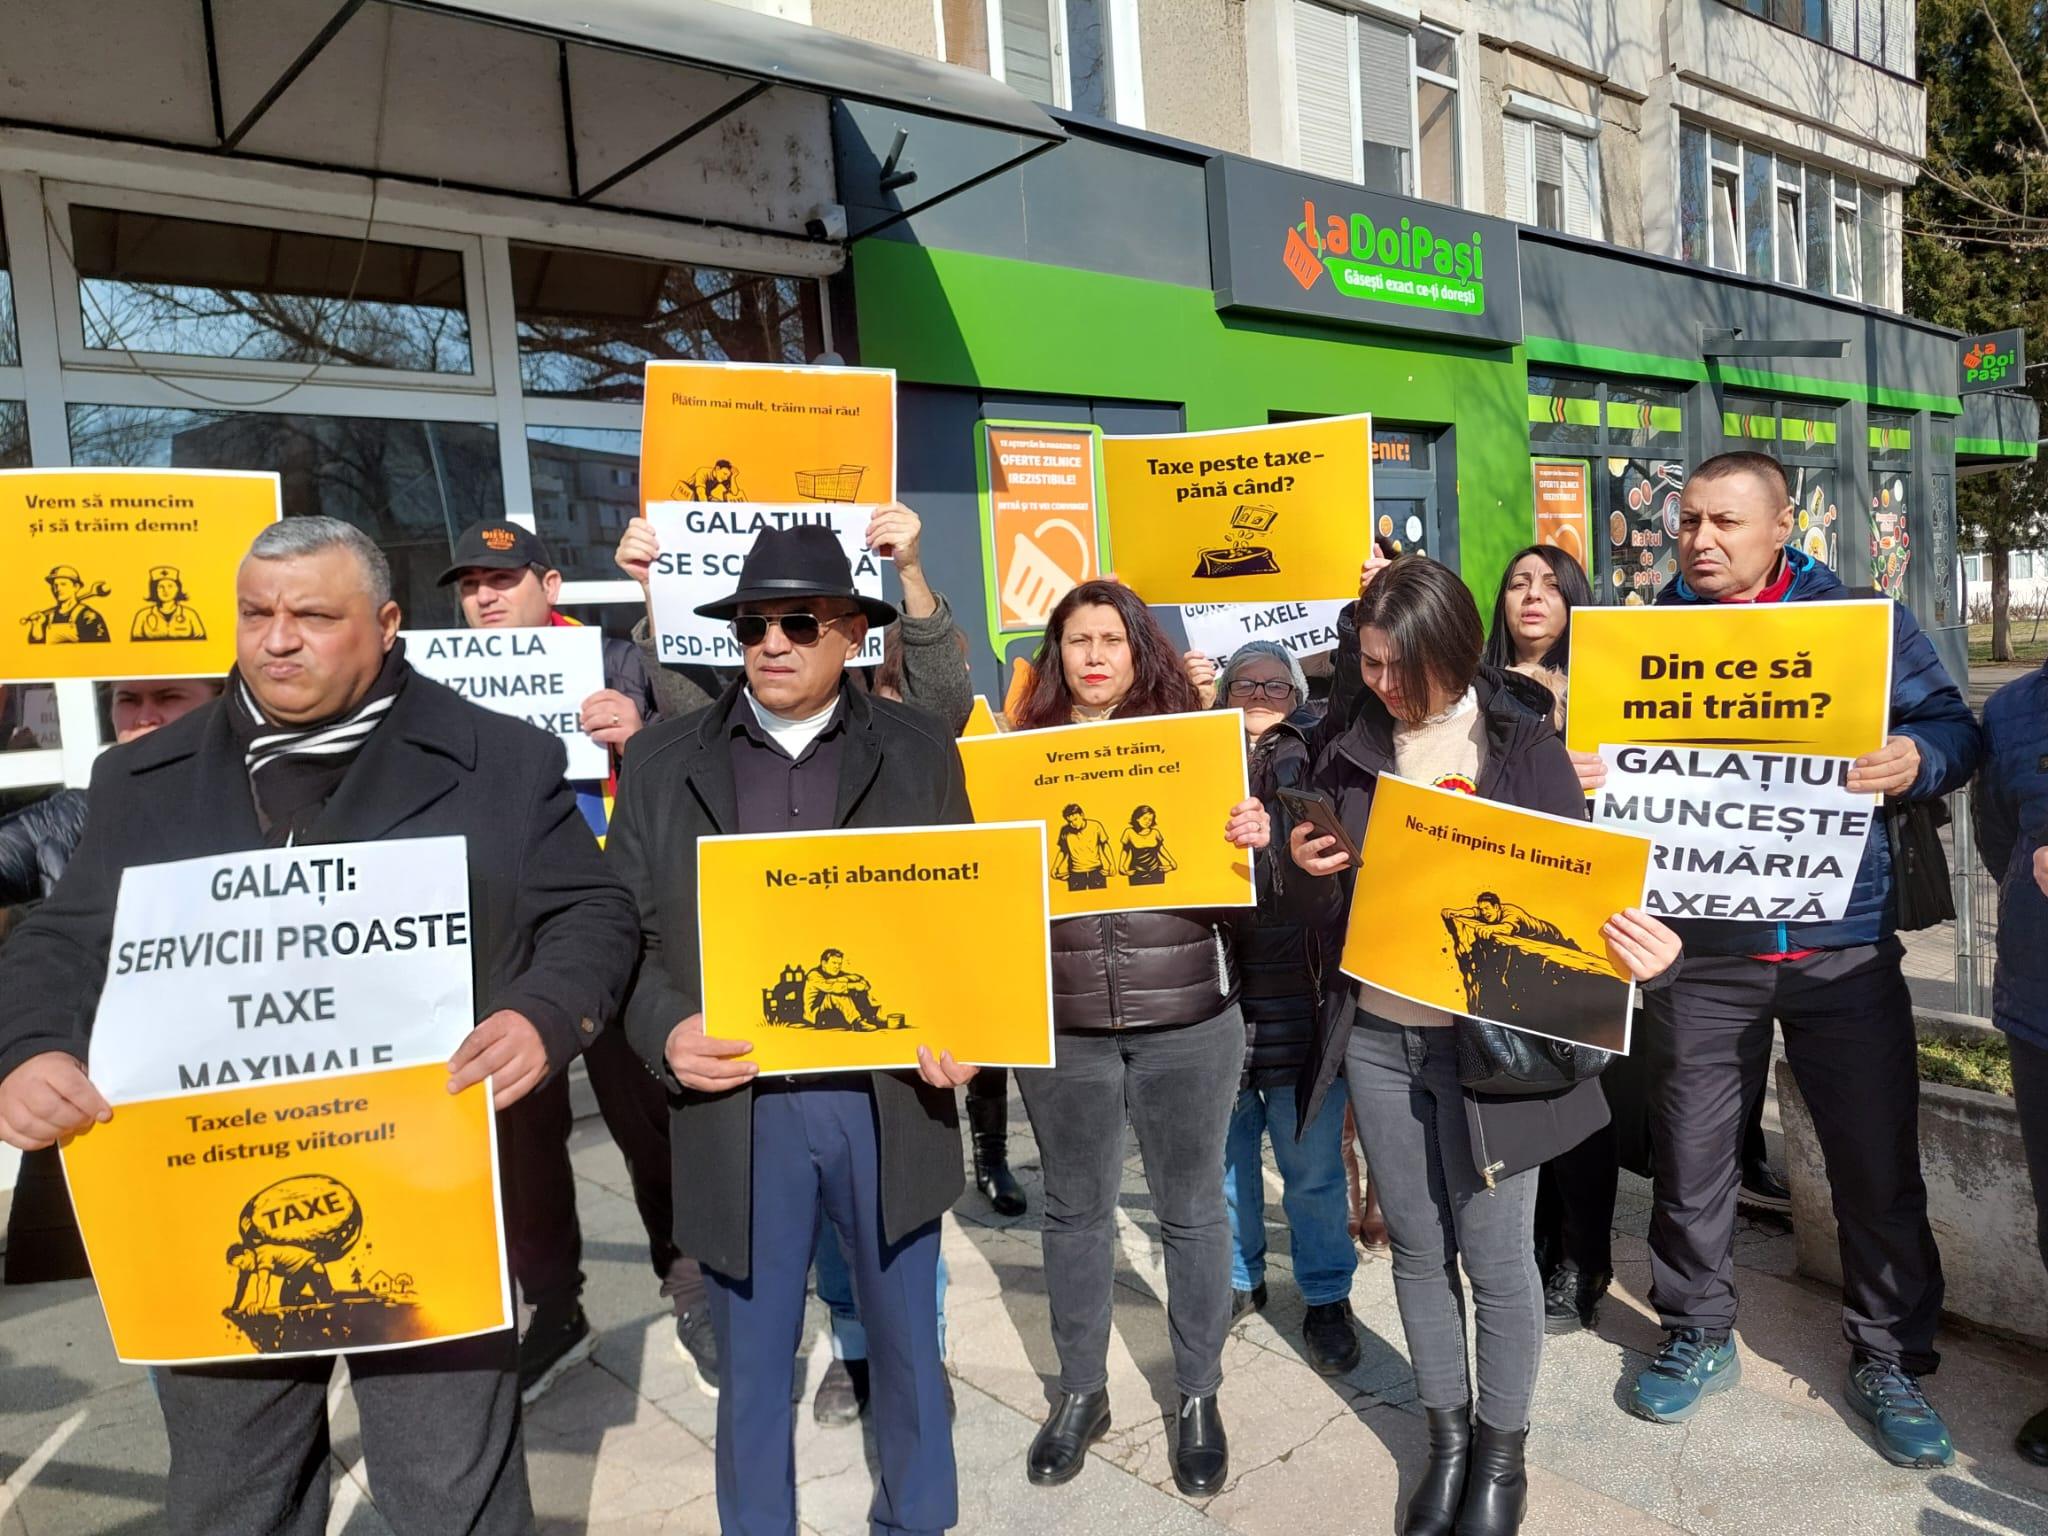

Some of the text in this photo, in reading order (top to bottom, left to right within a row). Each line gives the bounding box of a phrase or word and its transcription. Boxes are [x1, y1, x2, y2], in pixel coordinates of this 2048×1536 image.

[1344, 269, 1475, 307] Găsești exact ce-ți dorești
[1983, 350, 2014, 369] Doi
[1967, 366, 2006, 383] Pași
[710, 398, 732, 409] mai
[735, 400, 768, 412] mult,
[771, 403, 806, 413] trăim
[809, 405, 833, 416] mai
[1000, 454, 1040, 466] OFERTE
[1372, 437, 1410, 461] enit!
[1148, 458, 1193, 475] Taxe
[1199, 454, 1257, 476] peste
[1232, 476, 1294, 496] când?
[25, 494, 194, 508] Vrem să muncim
[30, 519, 199, 537] și să trăim demn!
[1632, 530, 1662, 547] Raftul
[657, 553, 692, 575] SE
[1640, 550, 1653, 566] de
[1240, 603, 1308, 633] TAXELE
[426, 634, 546, 659] ATAC LA
[1641, 652, 1812, 680] Din ce să
[445, 673, 564, 698] ZUNARE
[1623, 692, 1831, 719] mai trăim?
[1046, 741, 1165, 763] Vrem să trăim,
[1034, 762, 1180, 786] dar n-avem din ce!
[1603, 793, 1869, 842] MUNCEȘTE
[1405, 815, 1592, 876] Ne-ați împins la limită!
[1653, 845, 1843, 878] RIMĂRIA
[211, 858, 355, 904] GALAȚI:
[766, 863, 979, 888] Ne-ați abandonat!
[1646, 890, 1826, 919] AXEAZĂ
[115, 912, 467, 974] SERVICII PROASTE
[227, 987, 336, 1029] TAXE
[186, 1096, 369, 1134] Taxele voastre
[167, 1123, 397, 1168] ne distrug viitorul!
[262, 1192, 346, 1231] TAXE
